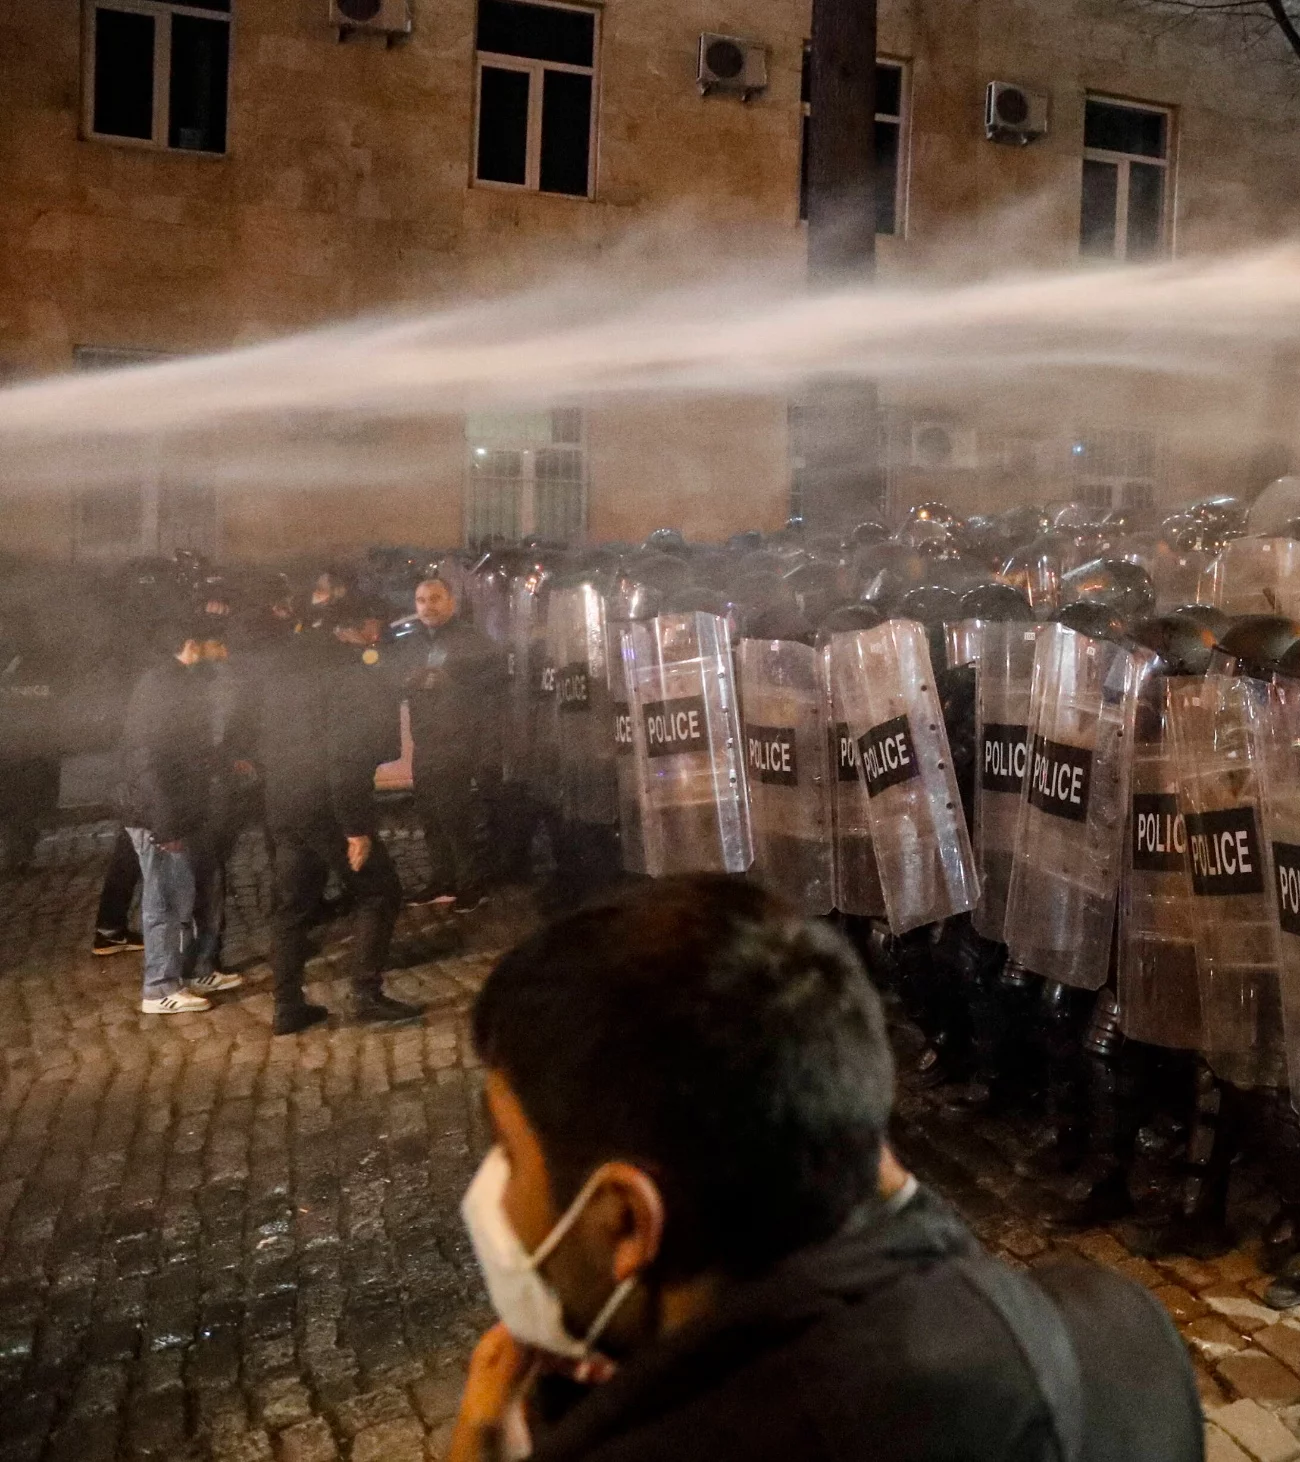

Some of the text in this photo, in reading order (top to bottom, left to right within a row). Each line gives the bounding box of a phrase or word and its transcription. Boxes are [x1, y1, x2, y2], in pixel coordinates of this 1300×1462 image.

[615, 716, 632, 742] ICE
[648, 711, 700, 743] POLICE
[749, 738, 791, 772] POLICE
[863, 733, 910, 782] POLICE
[985, 740, 1027, 777] POLIC
[1033, 753, 1083, 804] POLICE
[1138, 813, 1186, 852] POLIC
[1191, 830, 1252, 876] POLICE
